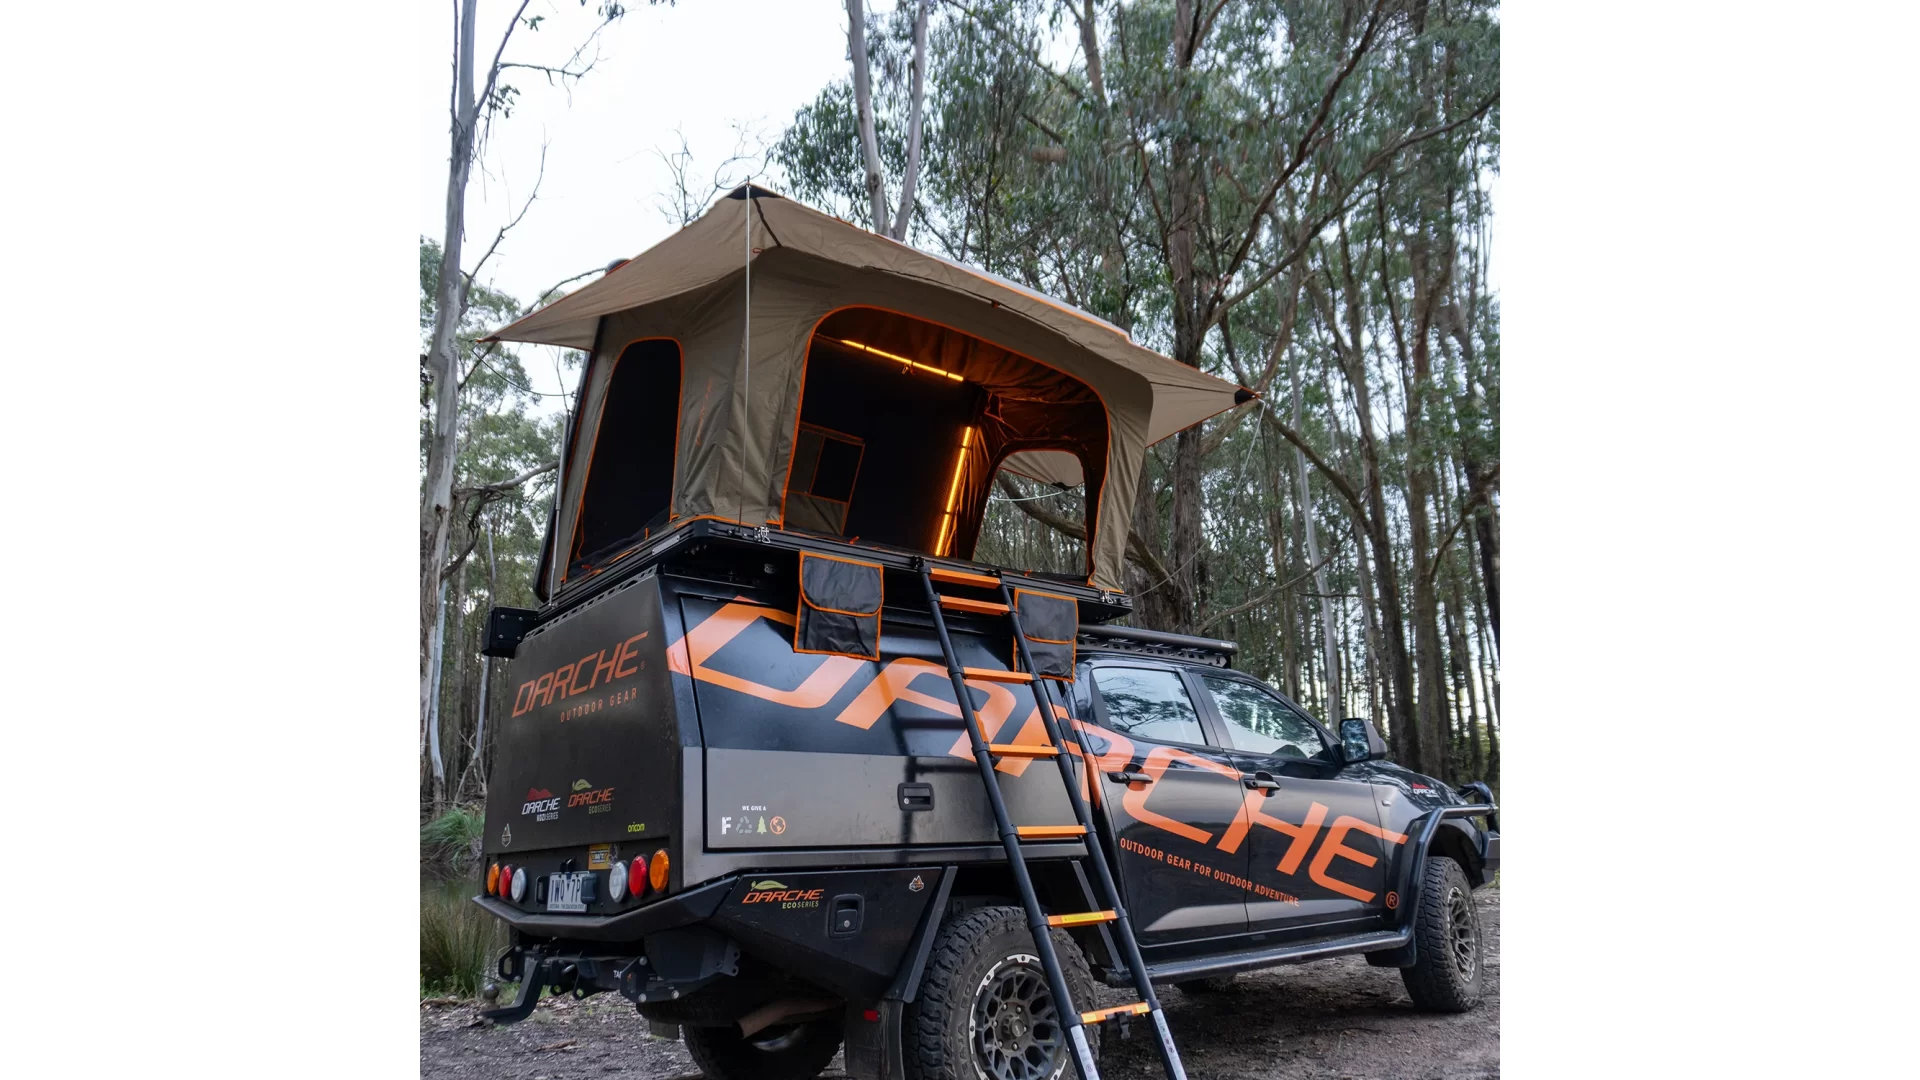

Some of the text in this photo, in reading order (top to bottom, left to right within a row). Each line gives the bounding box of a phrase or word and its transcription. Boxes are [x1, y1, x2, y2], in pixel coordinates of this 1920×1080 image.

[511, 631, 649, 718] DARCHE
[560, 687, 637, 723] OUTDOOR GEAR
[666, 594, 1409, 905] DARCHE
[521, 797, 561, 815] DARCHE
[567, 787, 615, 807] DARCHE
[721, 816, 732, 835] F
[1119, 837, 1300, 907] OUTDOOR GEAR FOR OUTDOOR ADVENTURE
[741, 889, 825, 904] DARCHE
[782, 900, 819, 909] ECOSERIES
